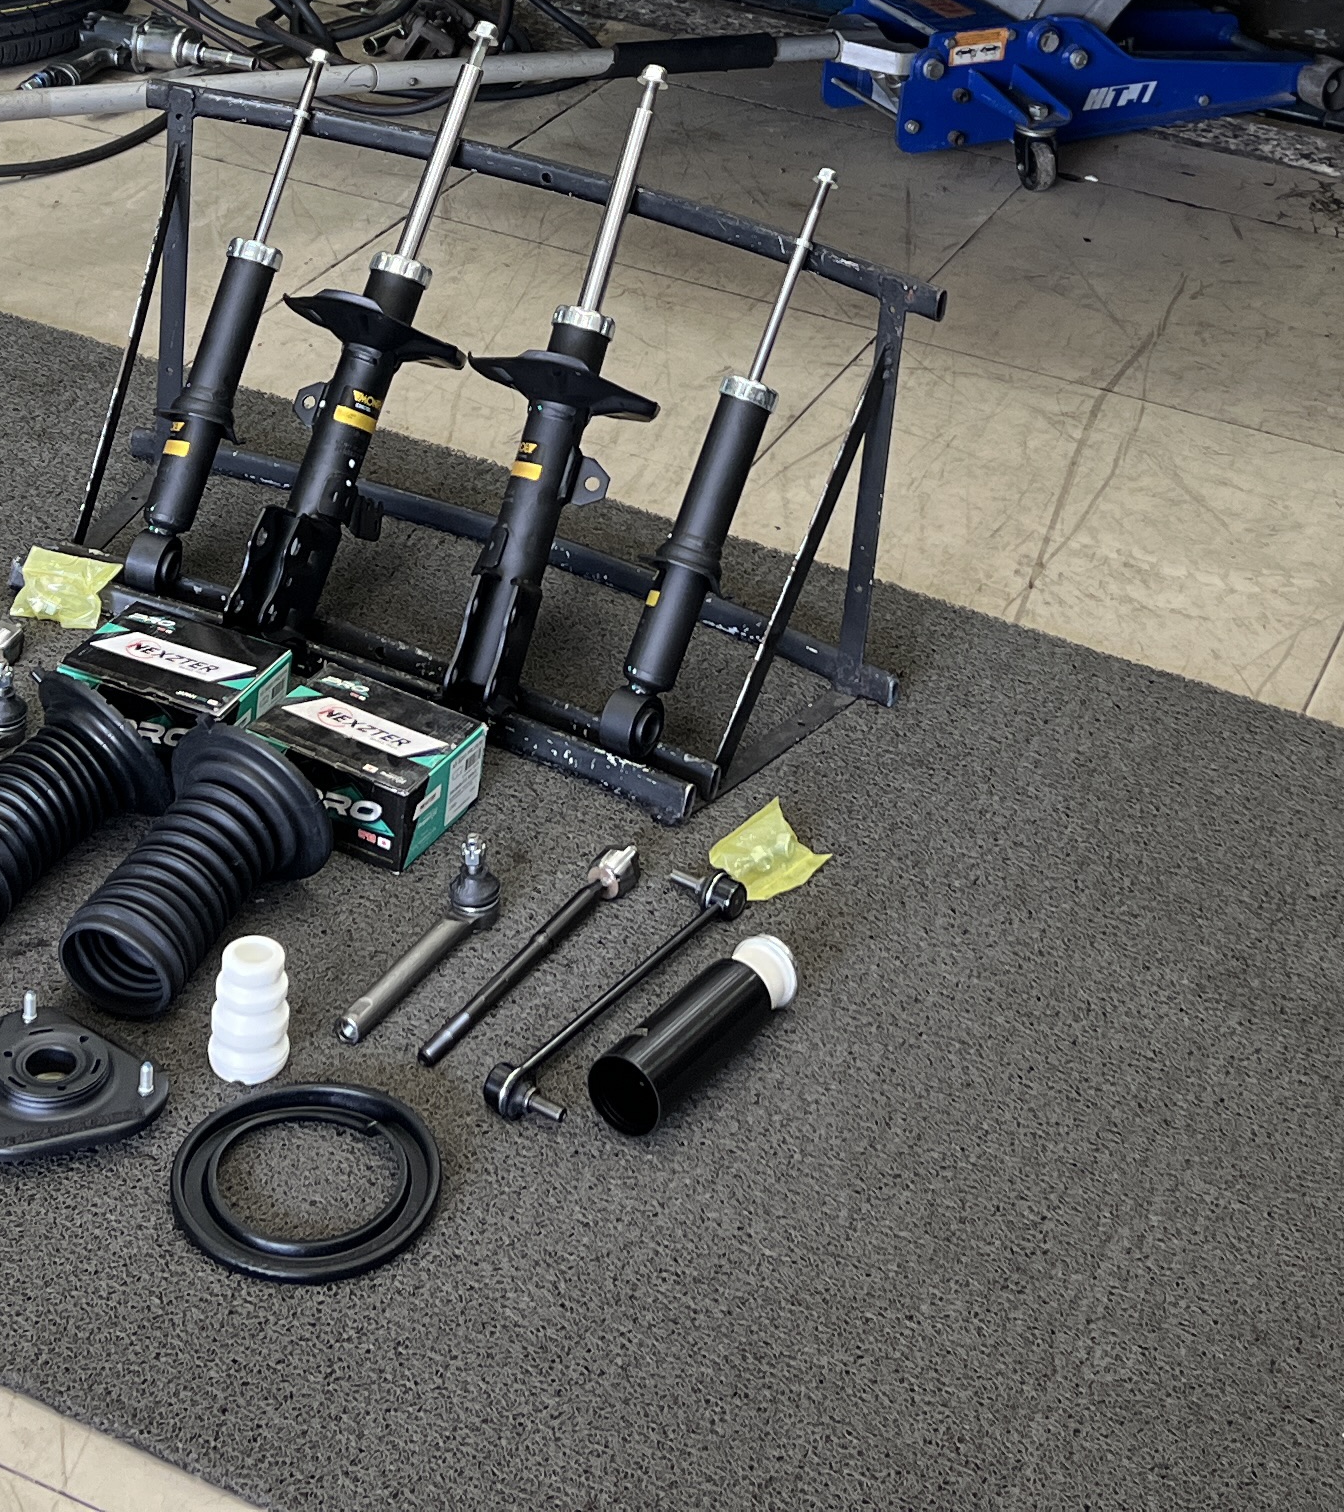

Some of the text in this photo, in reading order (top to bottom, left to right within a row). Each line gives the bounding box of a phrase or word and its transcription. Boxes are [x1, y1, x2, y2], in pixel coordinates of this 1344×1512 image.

[132, 641, 220, 673] NEXZTER
[323, 708, 412, 747] NEXZTER
[316, 788, 383, 822] RO
